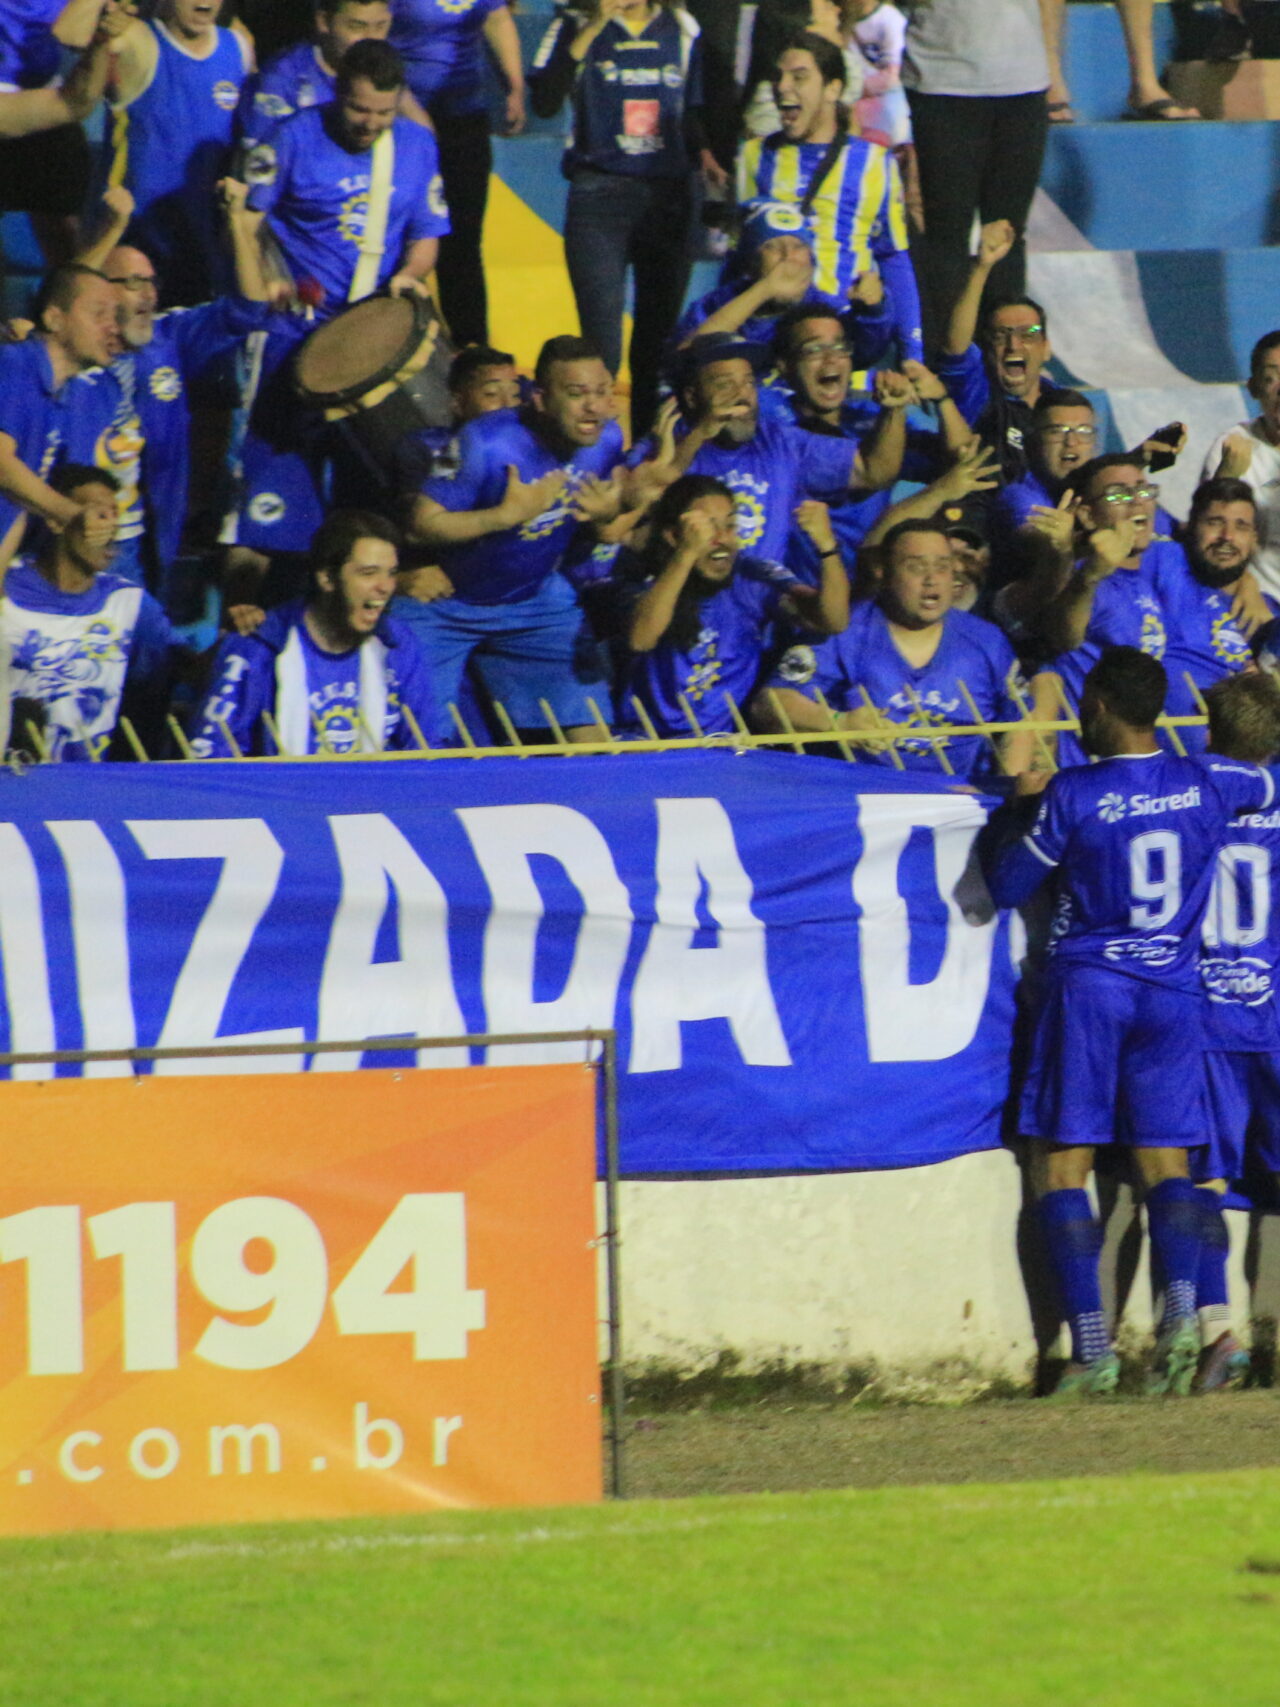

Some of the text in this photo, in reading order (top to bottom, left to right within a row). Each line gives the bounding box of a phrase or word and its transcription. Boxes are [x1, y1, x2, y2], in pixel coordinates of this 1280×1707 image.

[1129, 786, 1201, 817] Sicredi
[852, 793, 1028, 1063] D
[1129, 829, 1182, 931] 9
[0, 1192, 486, 1377] 1194
